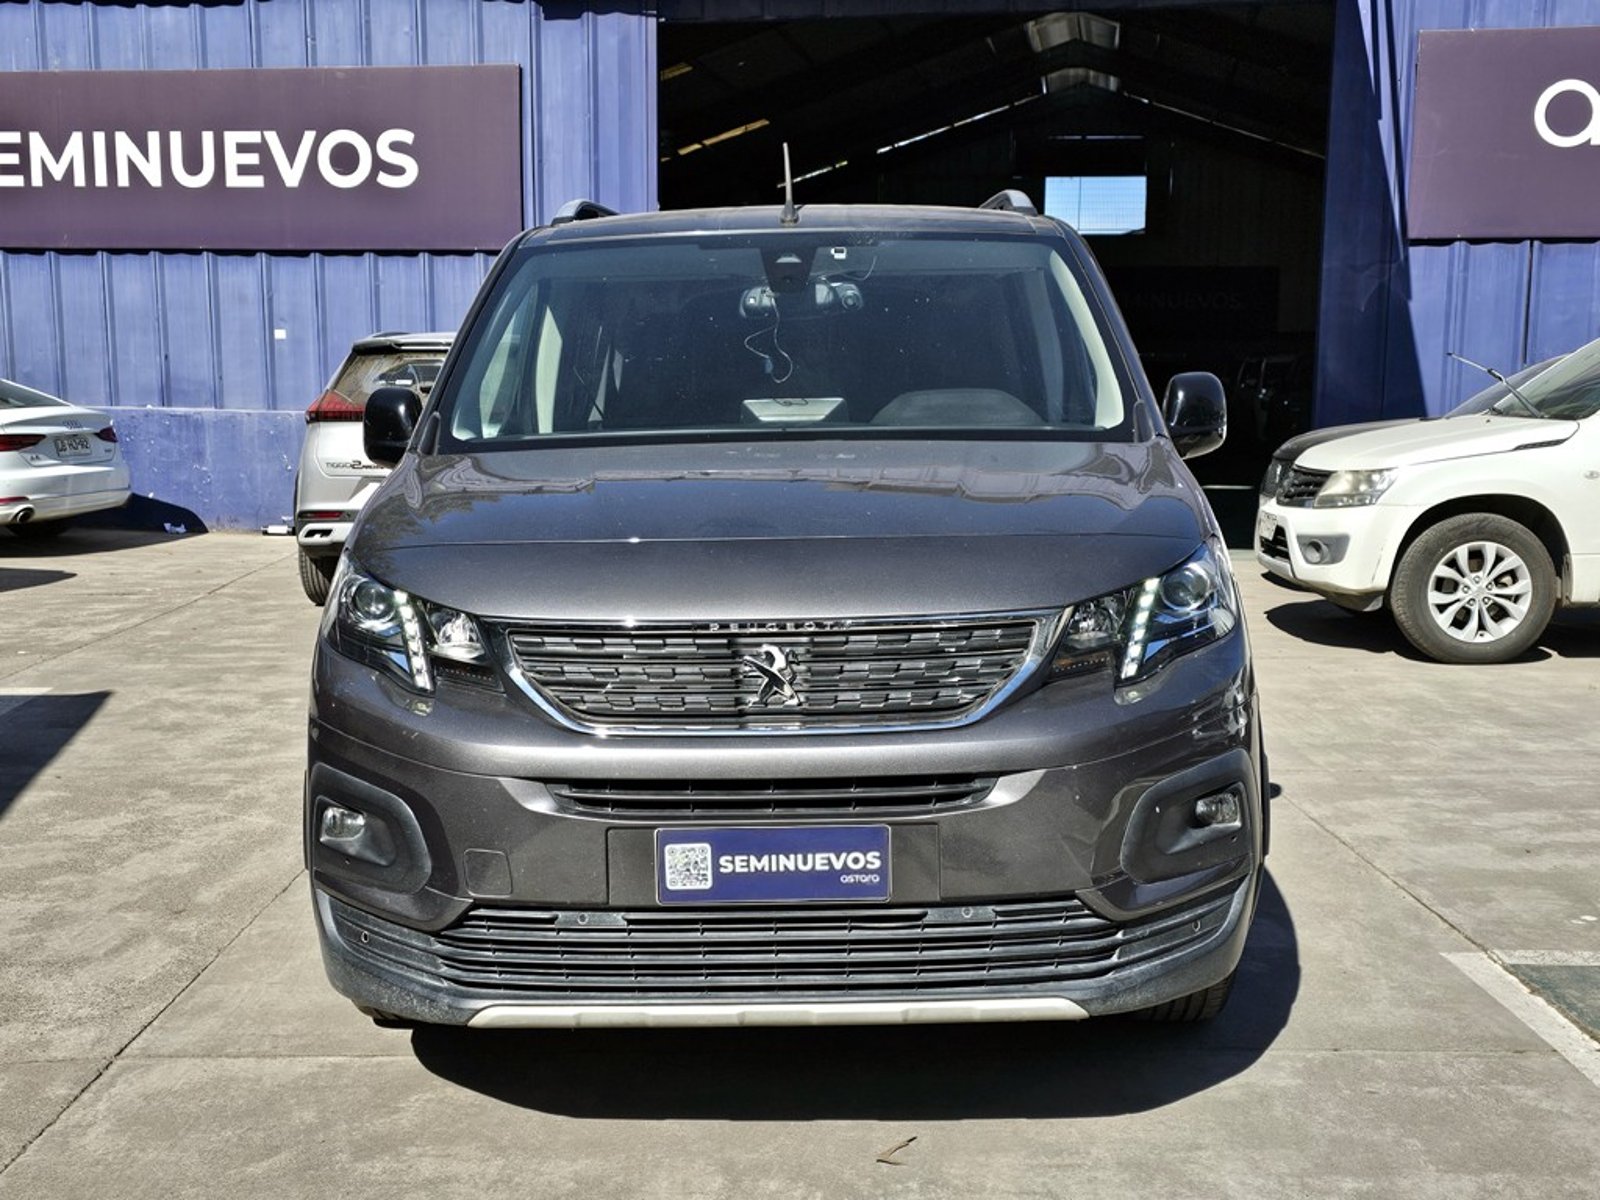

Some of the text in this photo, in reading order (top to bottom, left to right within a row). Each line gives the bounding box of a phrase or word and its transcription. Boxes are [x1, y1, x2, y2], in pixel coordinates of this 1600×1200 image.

[0, 128, 419, 189] EMINUEVOS
[708, 620, 834, 633] PEUGEOT
[718, 851, 882, 874] SEMINUEVOS
